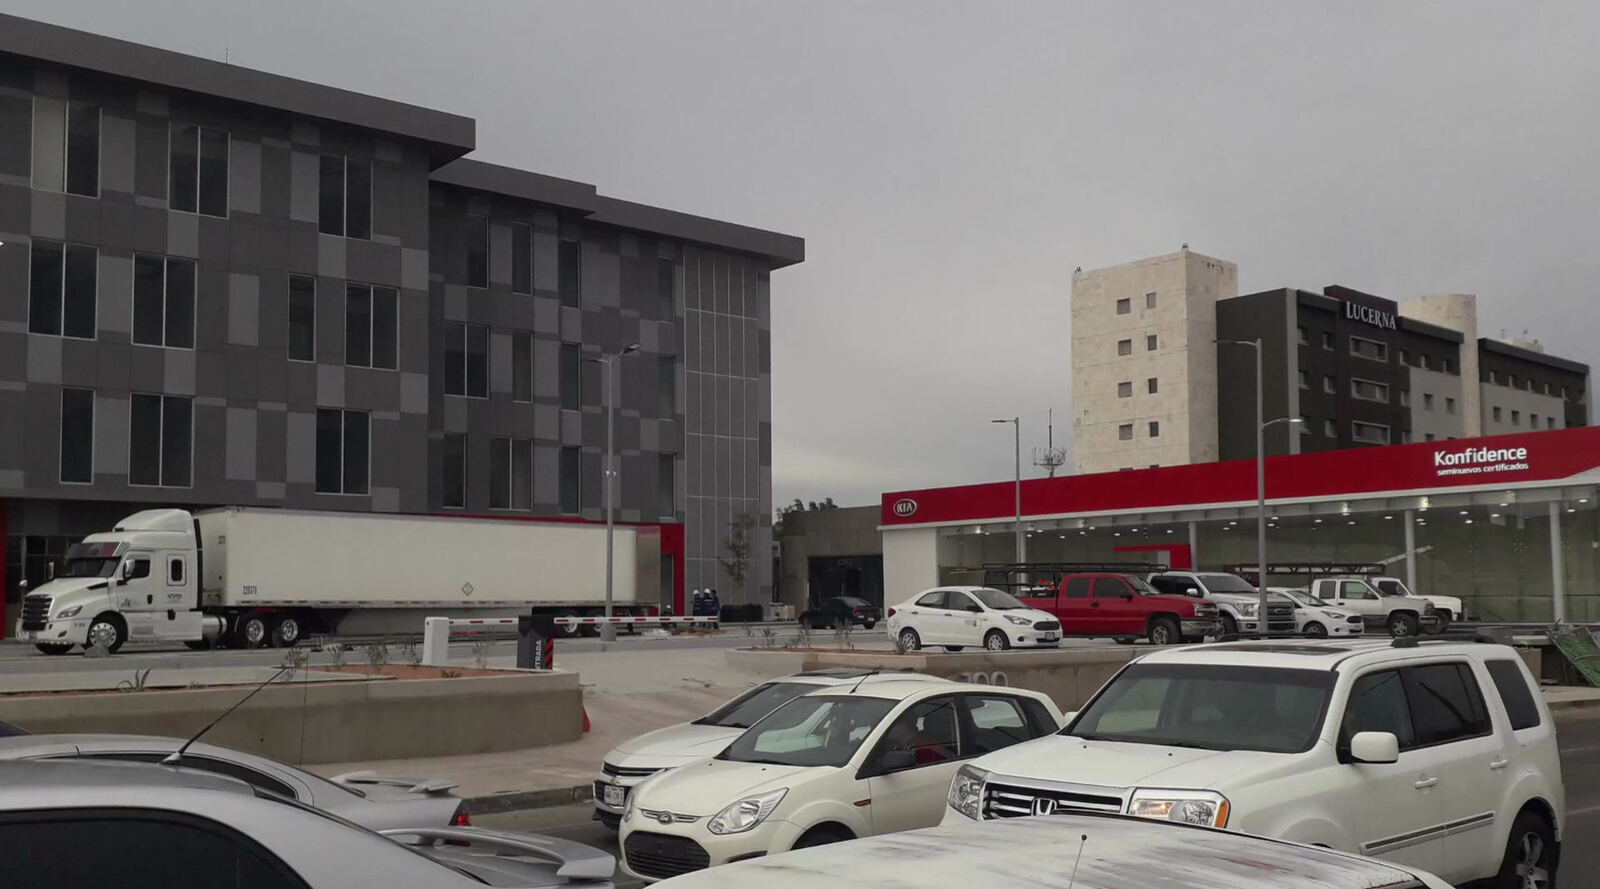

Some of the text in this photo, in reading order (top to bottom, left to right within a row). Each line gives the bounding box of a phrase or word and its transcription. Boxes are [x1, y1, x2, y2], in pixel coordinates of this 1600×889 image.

[1346, 301, 1397, 330] LUCERNA
[1434, 446, 1527, 466] Konfidence
[1437, 462, 1529, 476] seminuevos certificados
[895, 501, 914, 514] KIA
